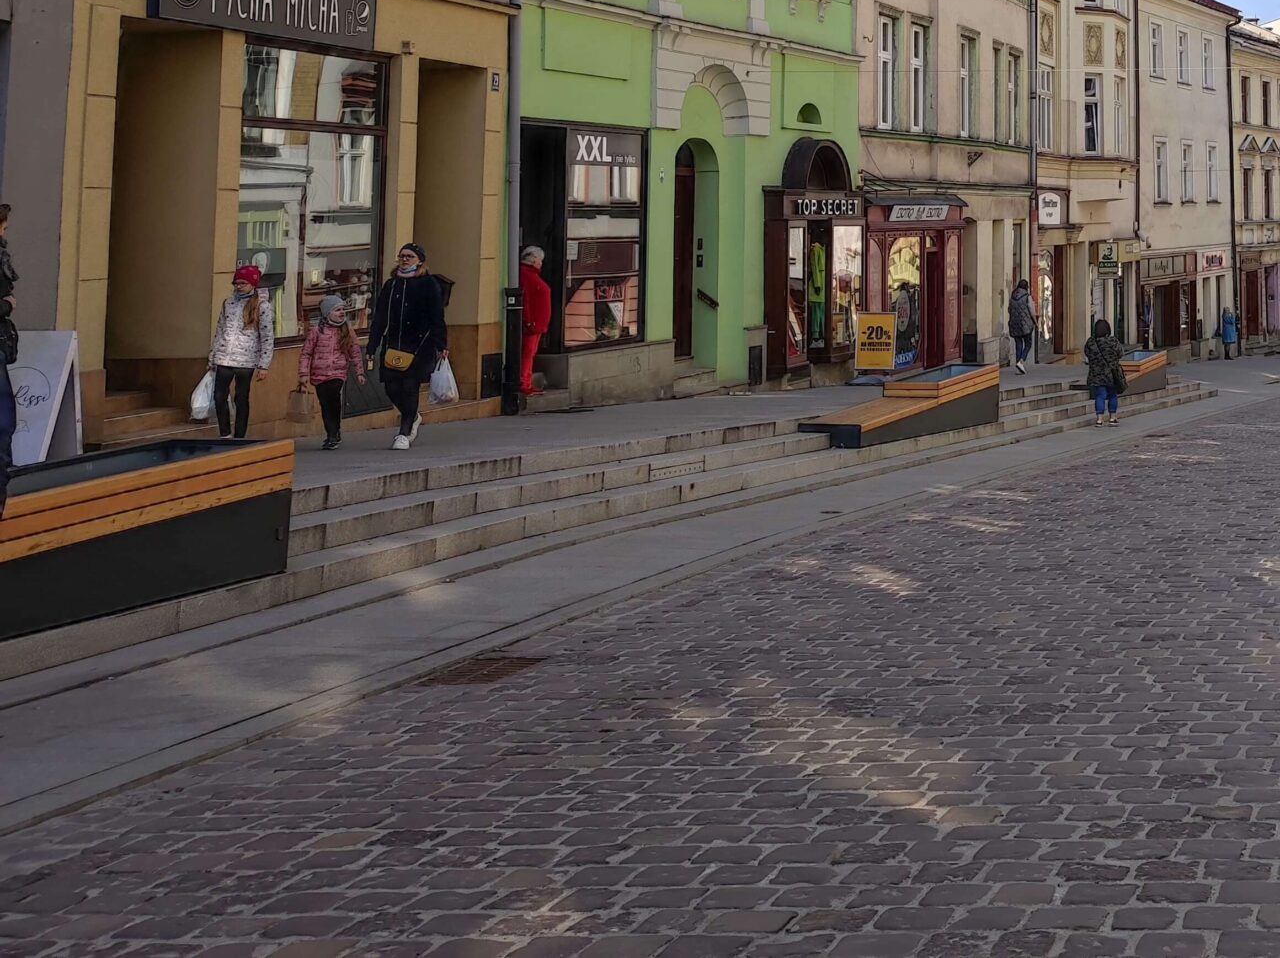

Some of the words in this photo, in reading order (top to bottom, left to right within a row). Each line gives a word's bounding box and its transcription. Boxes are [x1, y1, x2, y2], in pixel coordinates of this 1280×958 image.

[576, 135, 612, 162] XXL
[797, 199, 818, 215] TOP
[821, 199, 859, 215] SECRET
[861, 325, 892, 340] -20%
